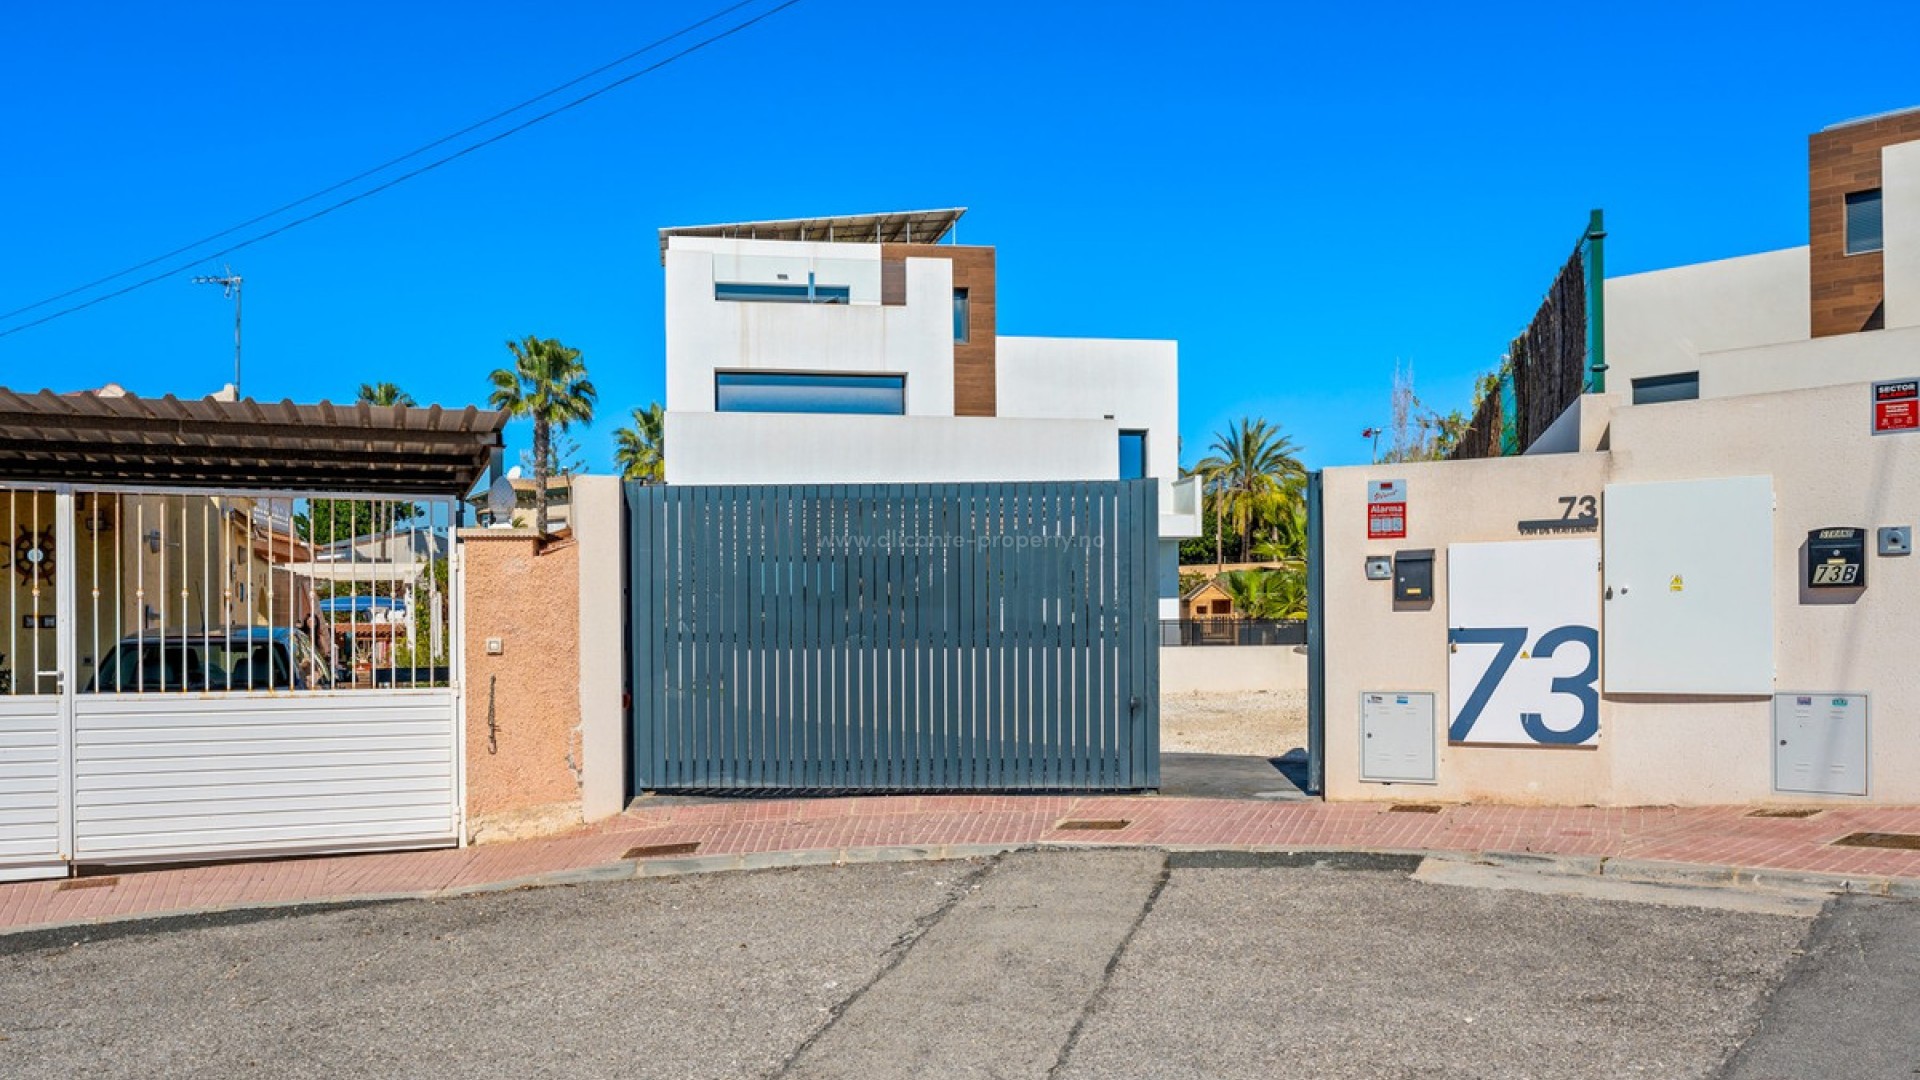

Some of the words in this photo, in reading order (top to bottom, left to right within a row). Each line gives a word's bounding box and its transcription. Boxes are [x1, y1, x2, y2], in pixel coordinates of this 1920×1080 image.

[1879, 383, 1916, 393] SECTOR
[1370, 504, 1404, 513] Alarma
[1558, 495, 1597, 520] 73
[1817, 565, 1857, 582] 73B
[1448, 625, 1599, 745] 73
